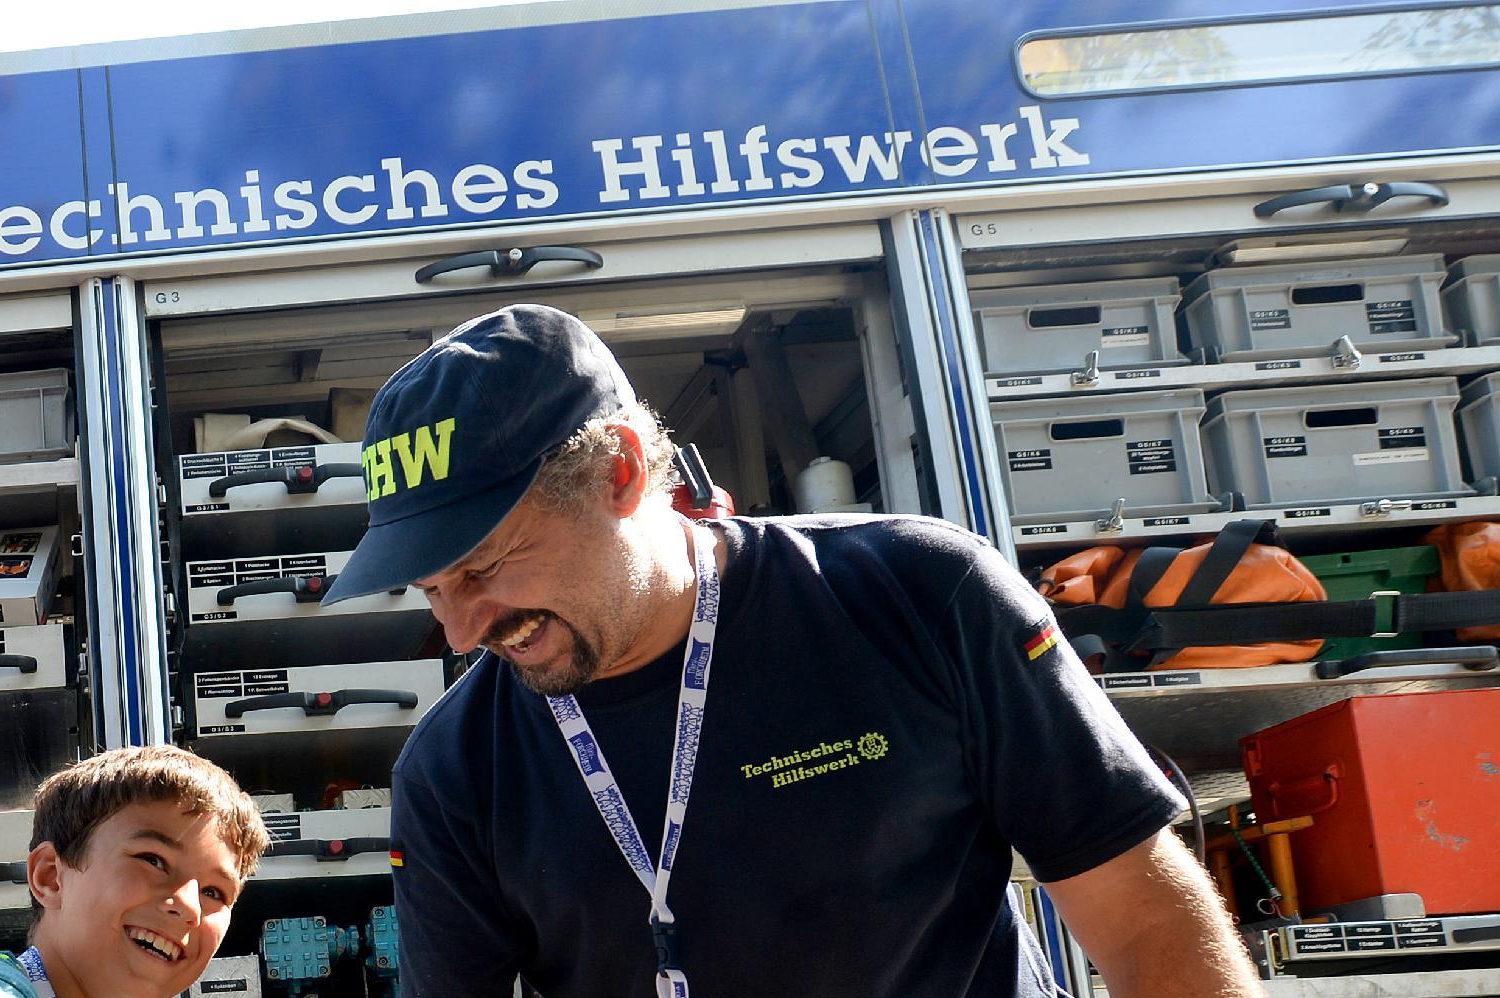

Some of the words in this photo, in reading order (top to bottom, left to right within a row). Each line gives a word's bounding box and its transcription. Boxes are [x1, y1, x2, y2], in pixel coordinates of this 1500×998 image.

[592, 105, 1091, 203] Hilfswerk
[971, 224, 983, 236] G
[987, 223, 997, 235] 5
[155, 292, 167, 304] G
[171, 291, 180, 303] 3
[740, 739, 853, 779] Technisches
[771, 753, 861, 789] Hilfswerk
